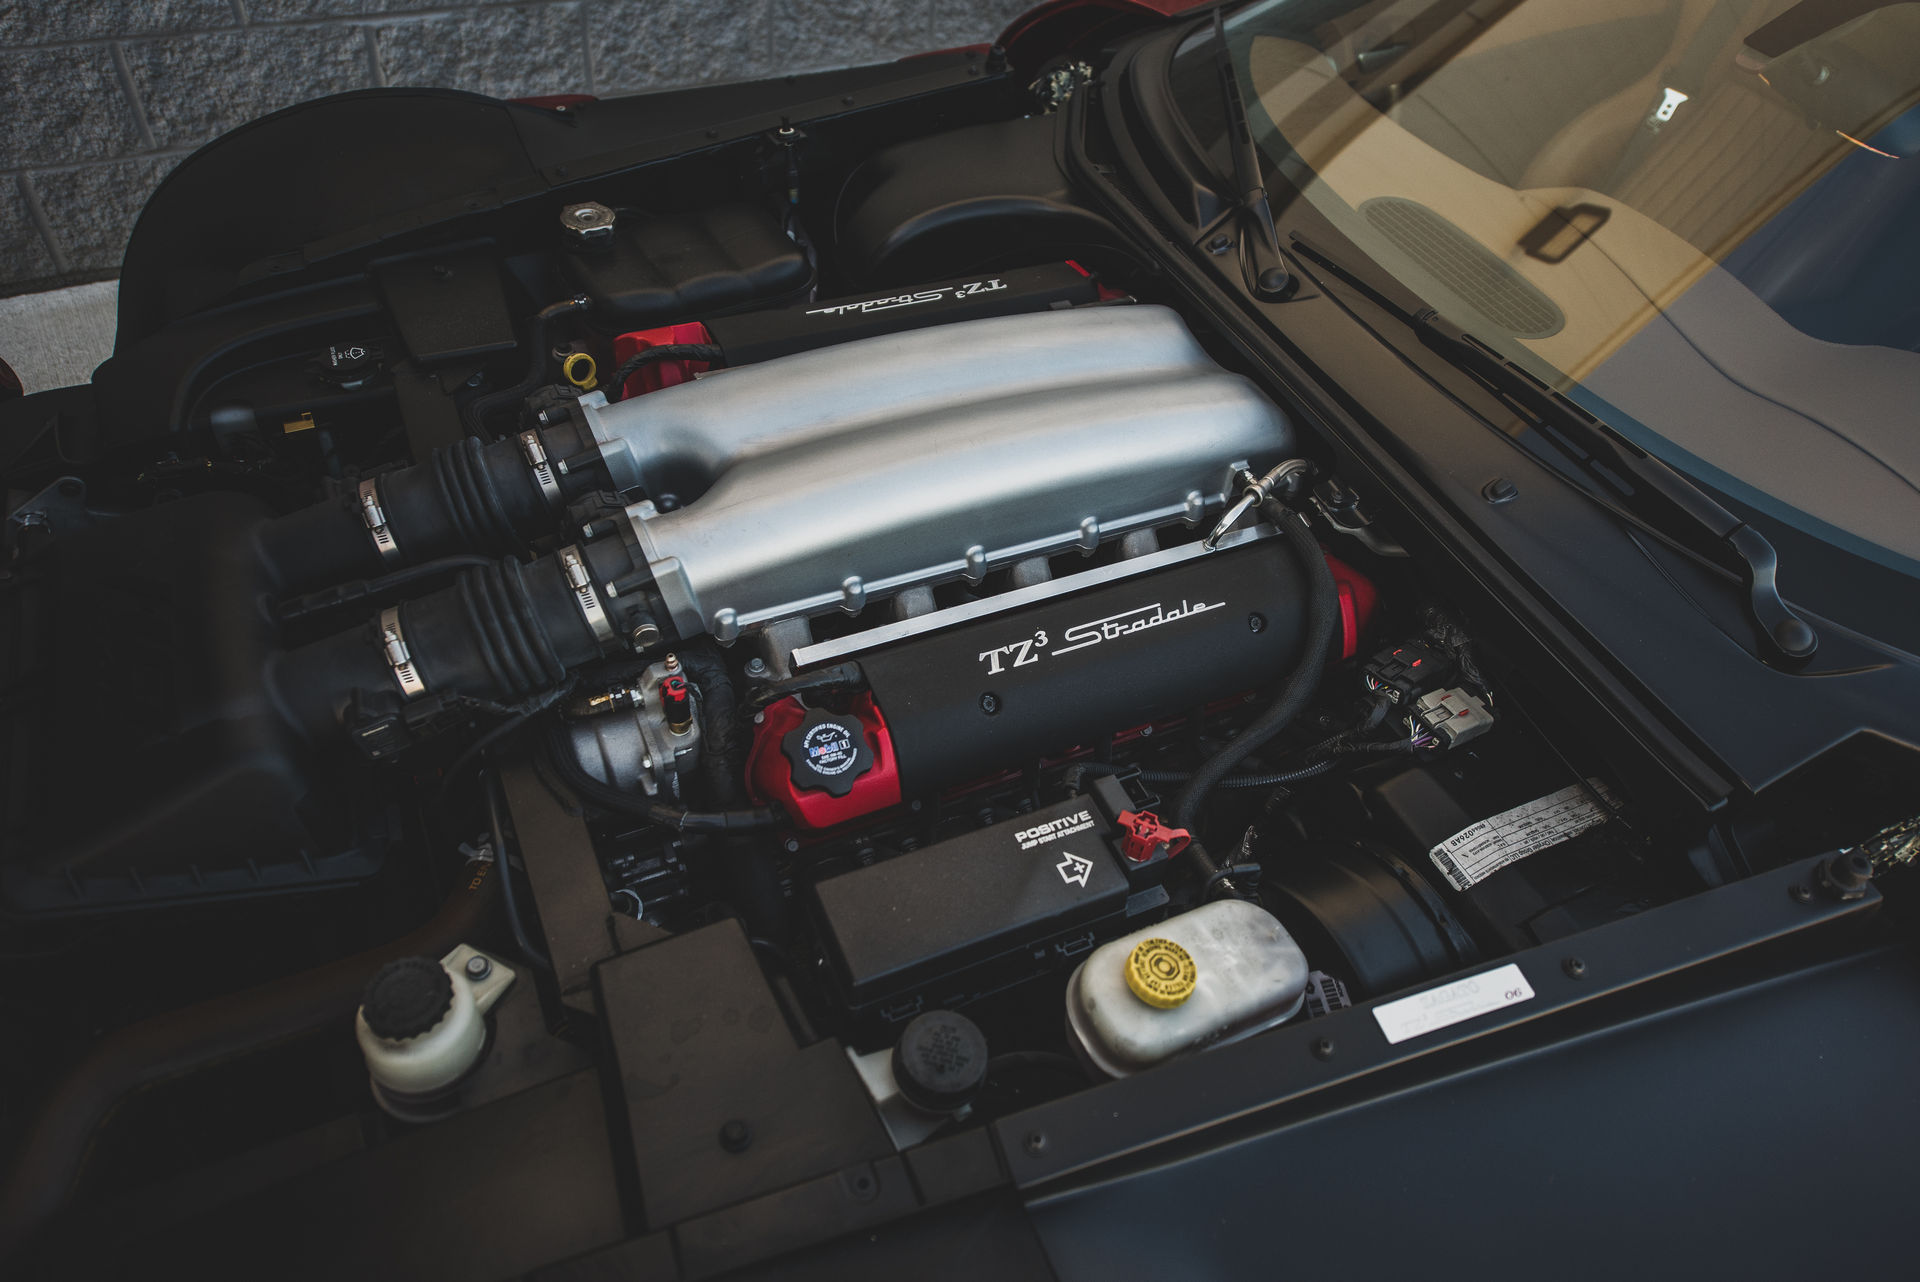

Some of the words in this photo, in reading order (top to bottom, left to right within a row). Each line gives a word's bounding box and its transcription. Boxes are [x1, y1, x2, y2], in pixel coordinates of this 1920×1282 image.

[806, 287, 953, 315] Stradale
[1051, 600, 1226, 656] Stradale
[808, 741, 839, 758] Mobil
[1014, 810, 1092, 843] POSITIVE
[1037, 832, 1057, 844] START
[1056, 820, 1095, 839] ATTACHMENT
[1508, 850, 1520, 861] LLC
